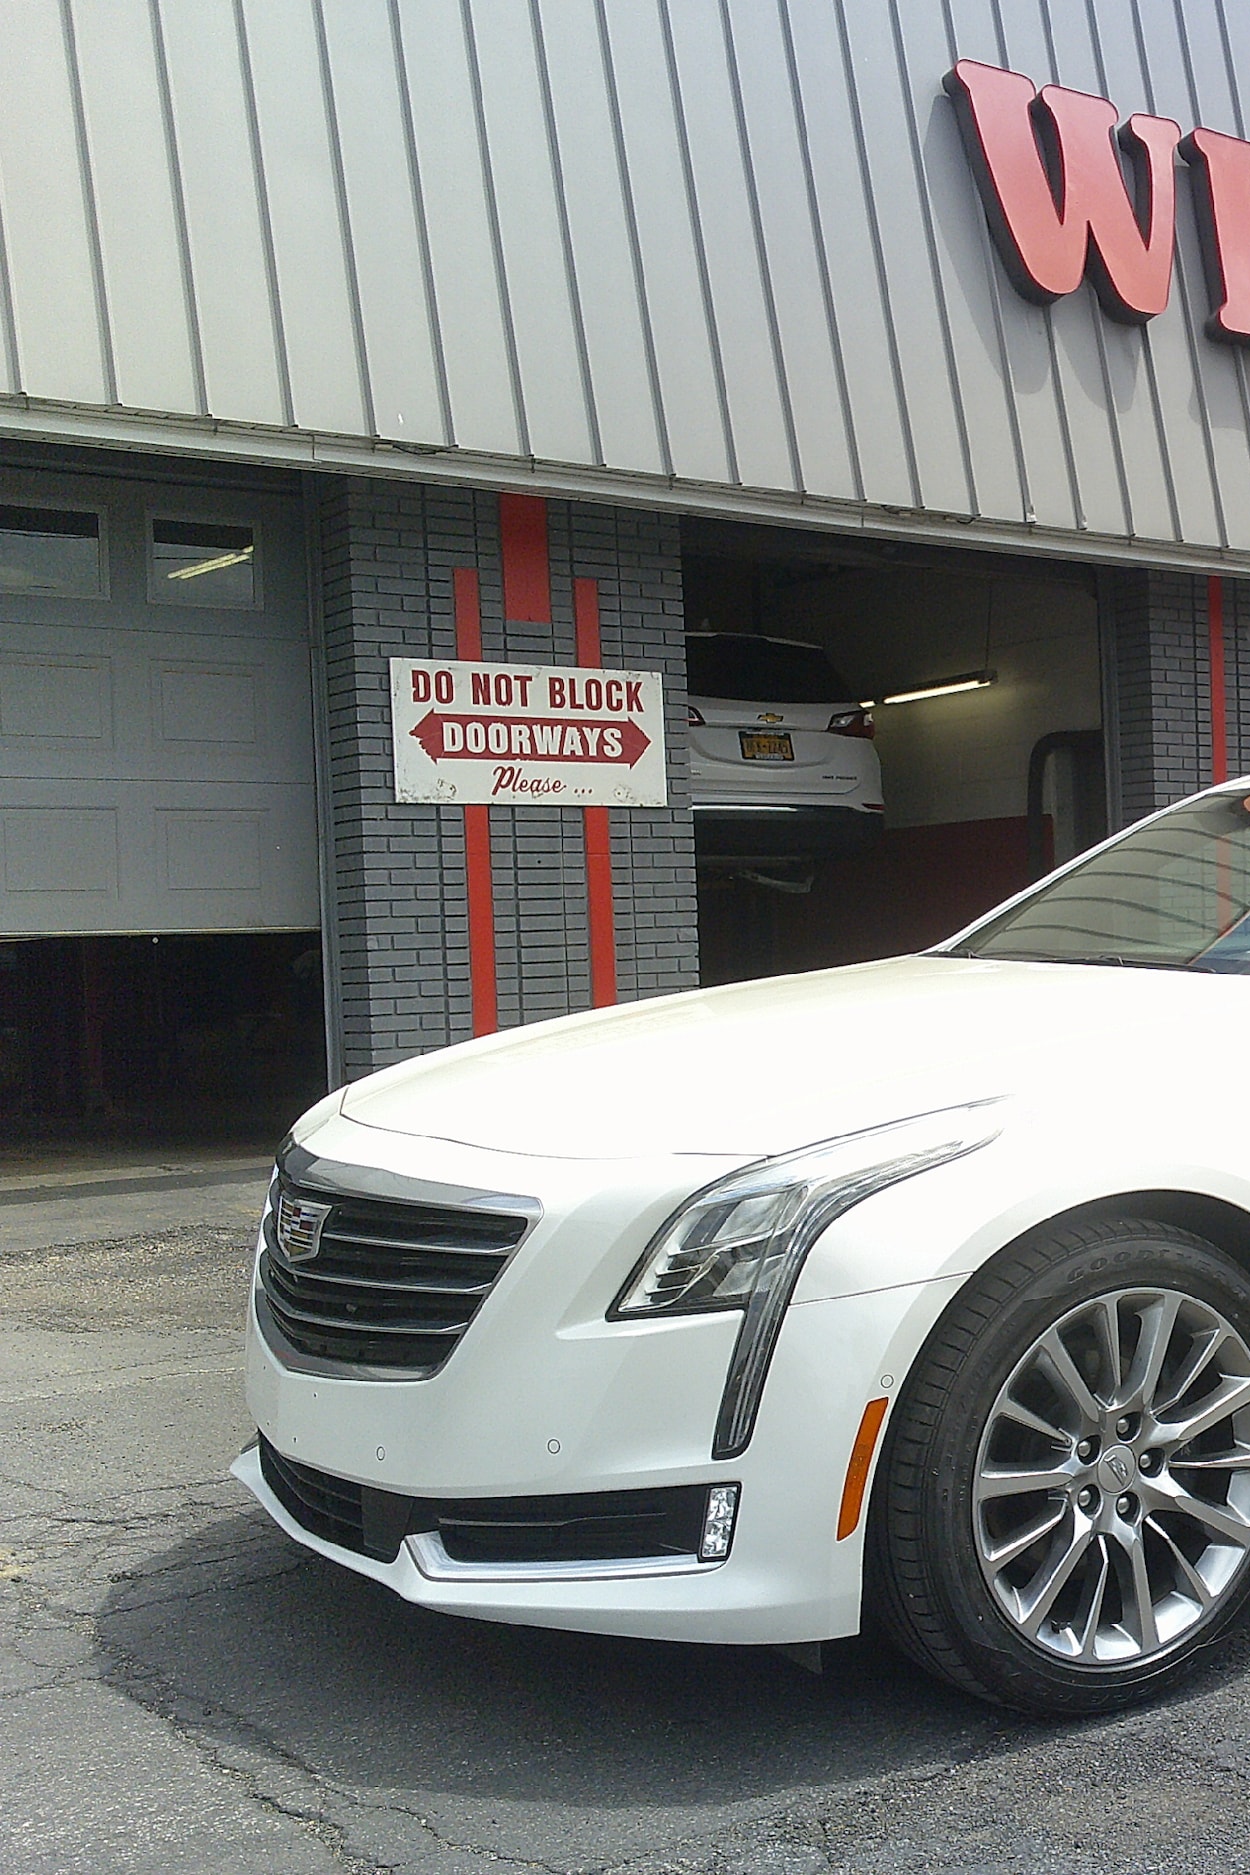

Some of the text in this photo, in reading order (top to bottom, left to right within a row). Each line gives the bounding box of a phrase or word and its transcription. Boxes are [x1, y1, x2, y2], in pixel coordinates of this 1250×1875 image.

[411, 669, 644, 713] DO NOT BLOCK
[443, 721, 623, 758] DOORWAYS
